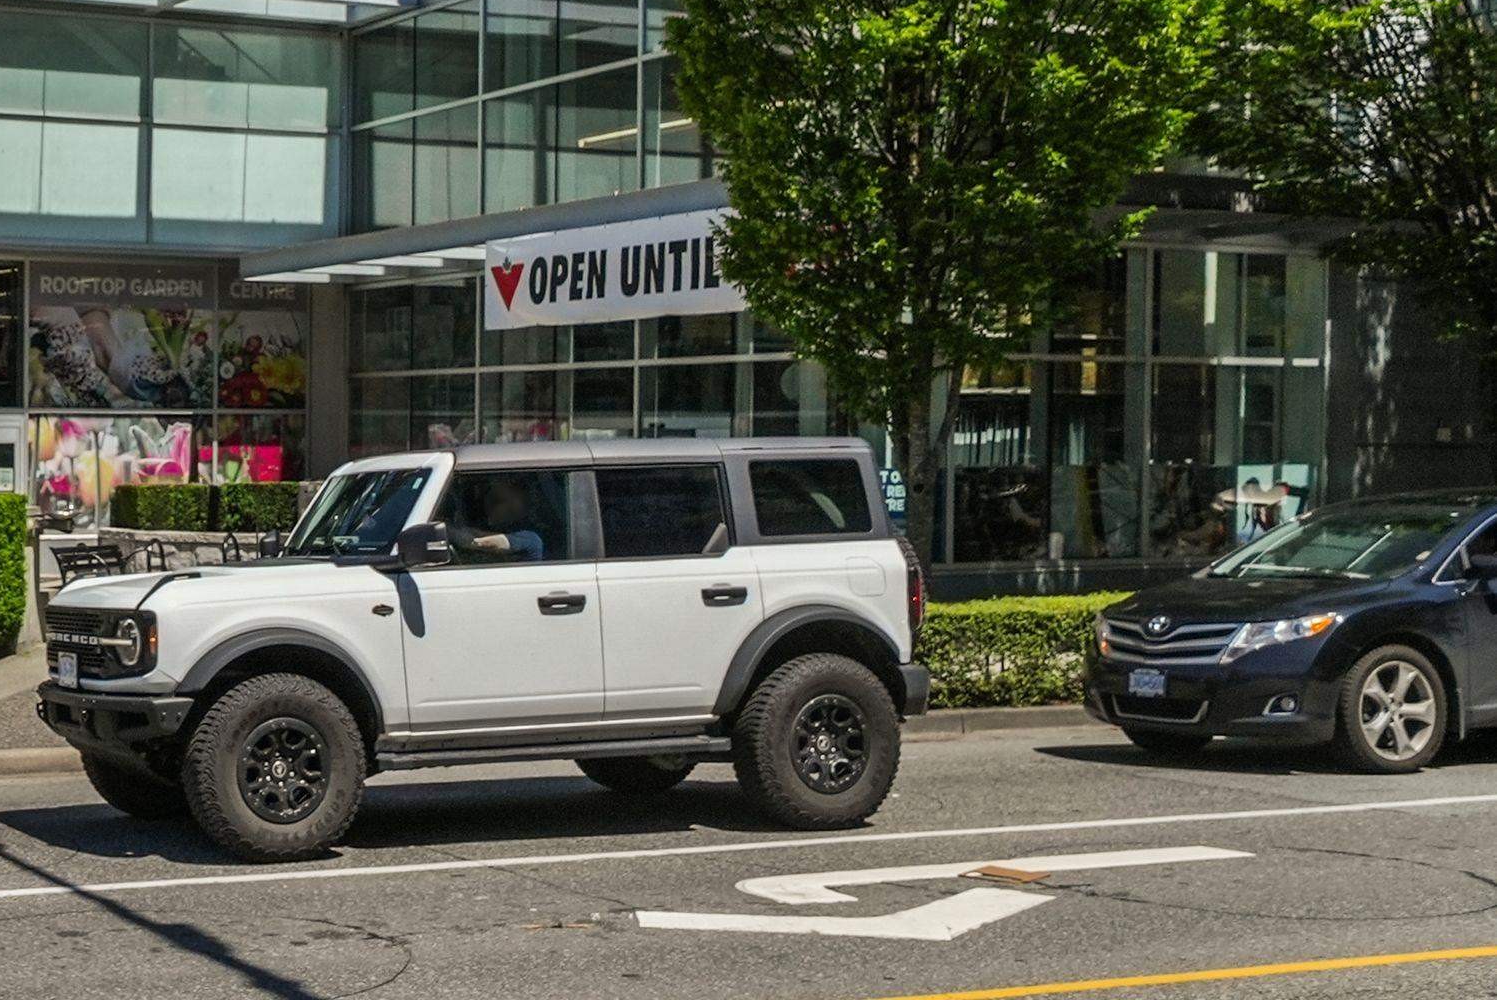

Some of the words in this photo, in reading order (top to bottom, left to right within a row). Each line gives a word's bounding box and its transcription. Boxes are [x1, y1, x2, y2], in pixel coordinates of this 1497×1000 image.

[40, 276, 126, 297] ROOFTOP
[129, 278, 203, 298] GARDEN
[229, 281, 297, 300] CENTRE
[529, 249, 608, 305] OPEN
[620, 236, 720, 298] UNTIL
